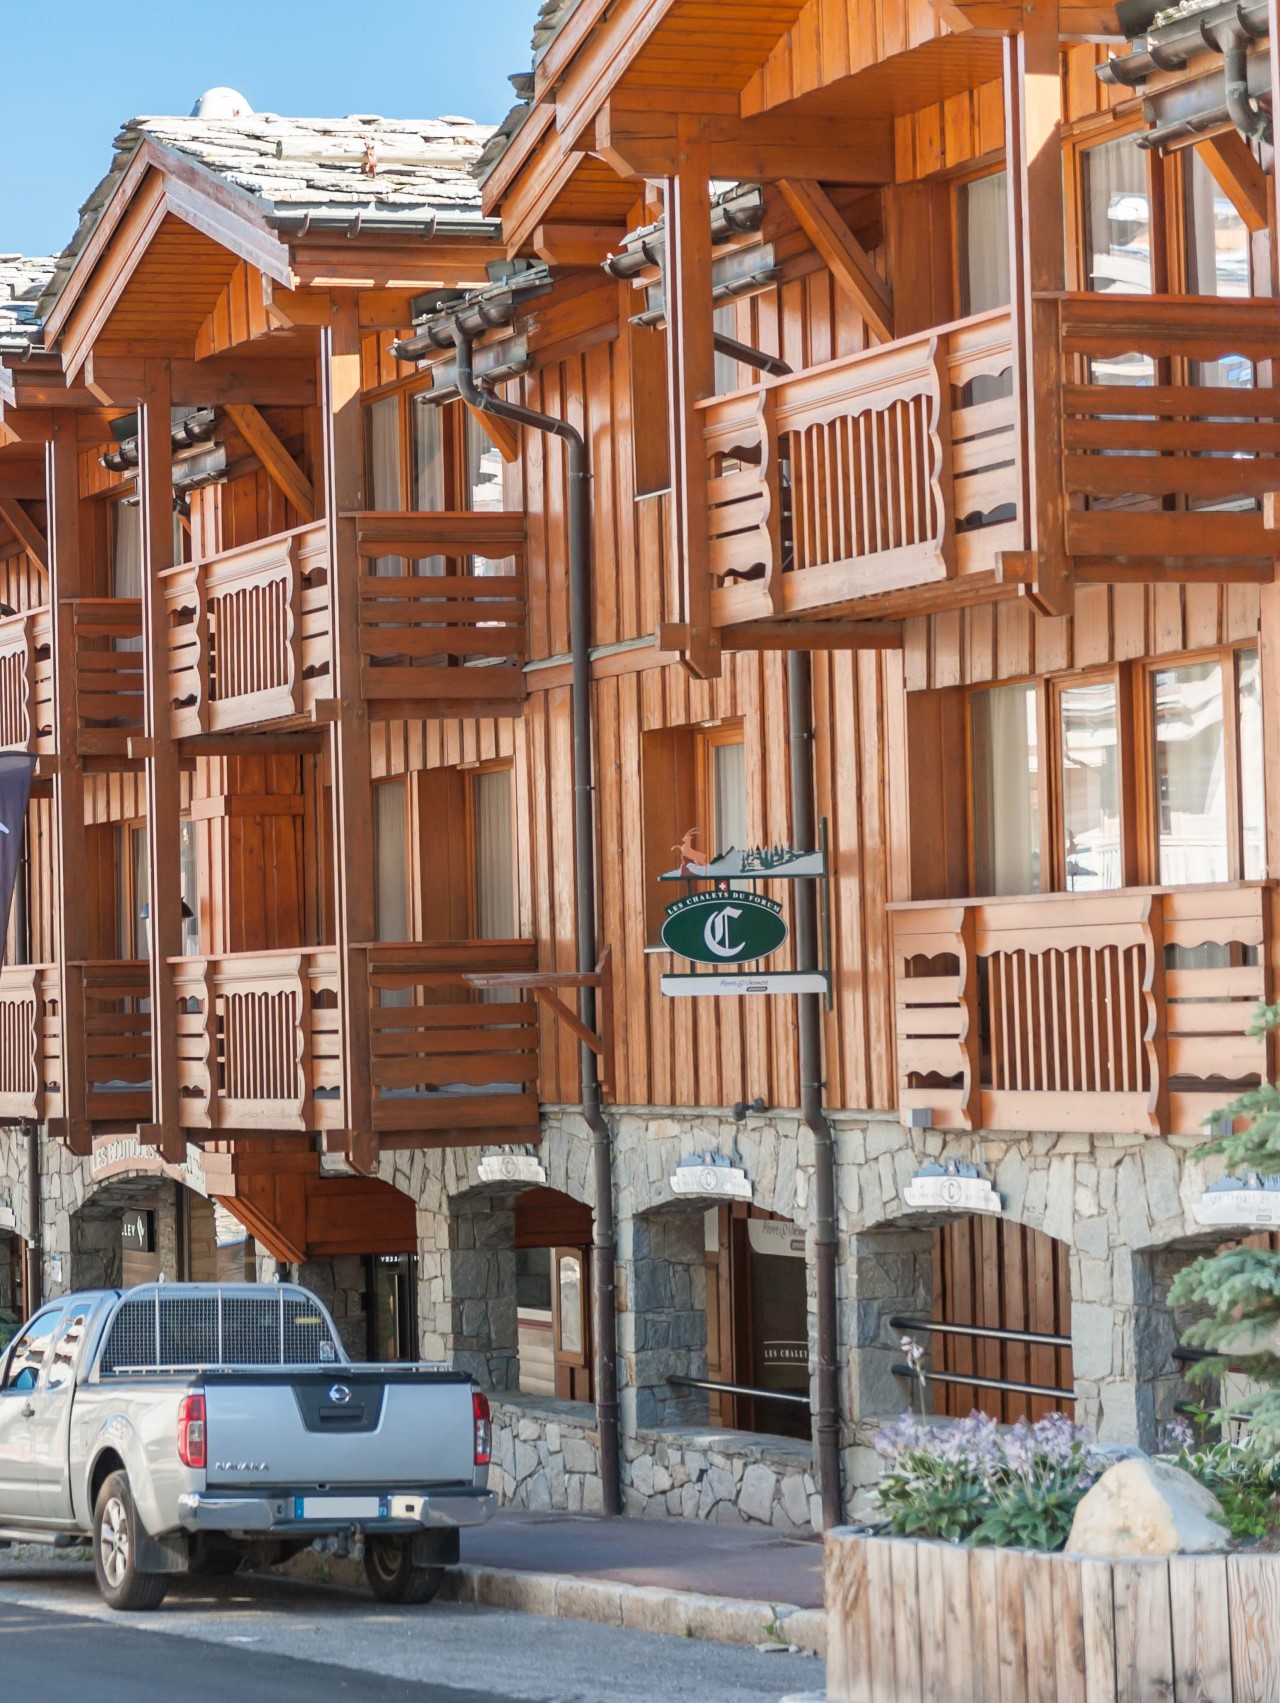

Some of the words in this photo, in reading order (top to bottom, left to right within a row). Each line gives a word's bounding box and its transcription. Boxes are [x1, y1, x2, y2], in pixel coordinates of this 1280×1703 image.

[667, 903, 684, 915] LES
[686, 892, 729, 904] CHALETS
[732, 892, 745, 900] DU
[749, 895, 781, 913] FORUM
[703, 906, 746, 957] C
[92, 1146, 107, 1172] LES
[764, 1349, 778, 1358] LES
[215, 1461, 269, 1471] NAVARA
